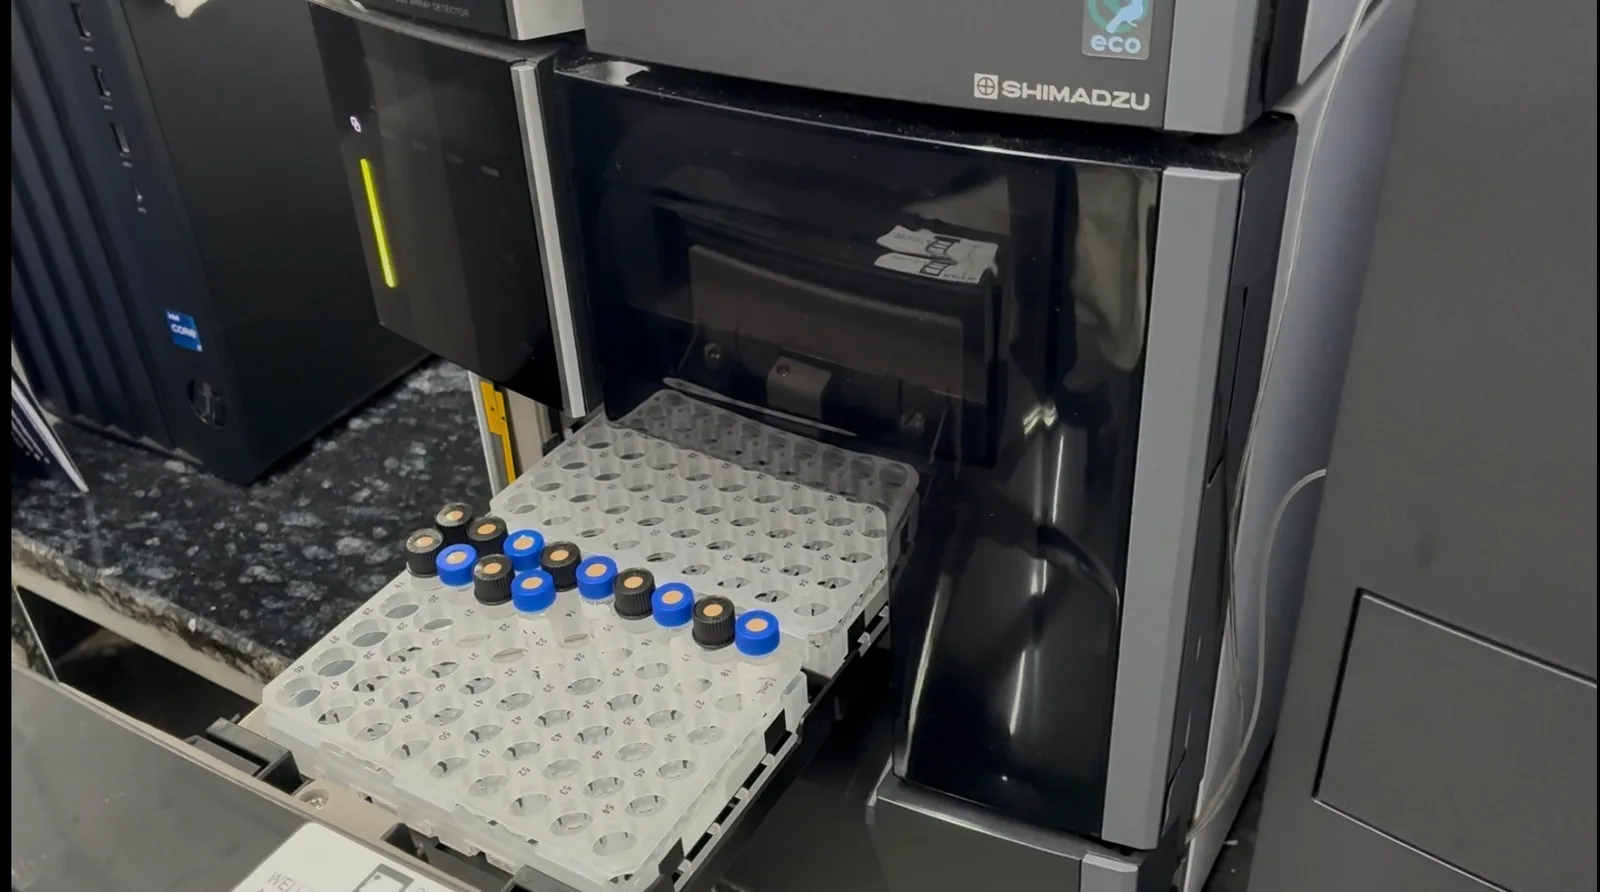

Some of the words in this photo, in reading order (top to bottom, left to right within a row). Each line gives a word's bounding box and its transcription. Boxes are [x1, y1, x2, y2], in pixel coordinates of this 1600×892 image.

[1090, 34, 1141, 54] eco
[1002, 80, 1150, 110] SHIMADZU
[428, 595, 439, 603] 20
[464, 609, 474, 617] 21
[397, 622, 408, 630] 29
[498, 623, 510, 631] 22
[603, 624, 613, 632] 15
[431, 637, 443, 646] 30
[536, 638, 547, 646] 23
[363, 651, 375, 660] 38
[574, 653, 585, 662] 24
[681, 654, 691, 662] 17
[399, 666, 410, 675] 39
[504, 668, 516, 676] 32
[612, 668, 624, 677] 25
[330, 681, 339, 690] 47
[543, 684, 555, 693] 33
[652, 684, 664, 693] 26
[364, 697, 375, 706] 48
[473, 699, 483, 707] 41
[583, 700, 594, 709] 34
[694, 700, 705, 709] 27
[401, 714, 412, 723] 49
[511, 716, 522, 725] 42
[622, 716, 634, 726] 35
[438, 731, 451, 740] 50
[664, 733, 676, 742] 36
[478, 749, 490, 758] 51
[592, 750, 603, 760] 44
[517, 767, 530, 776] 52
[634, 768, 645, 777] 45
[559, 785, 572, 795] 53
[602, 804, 615, 814] 54
